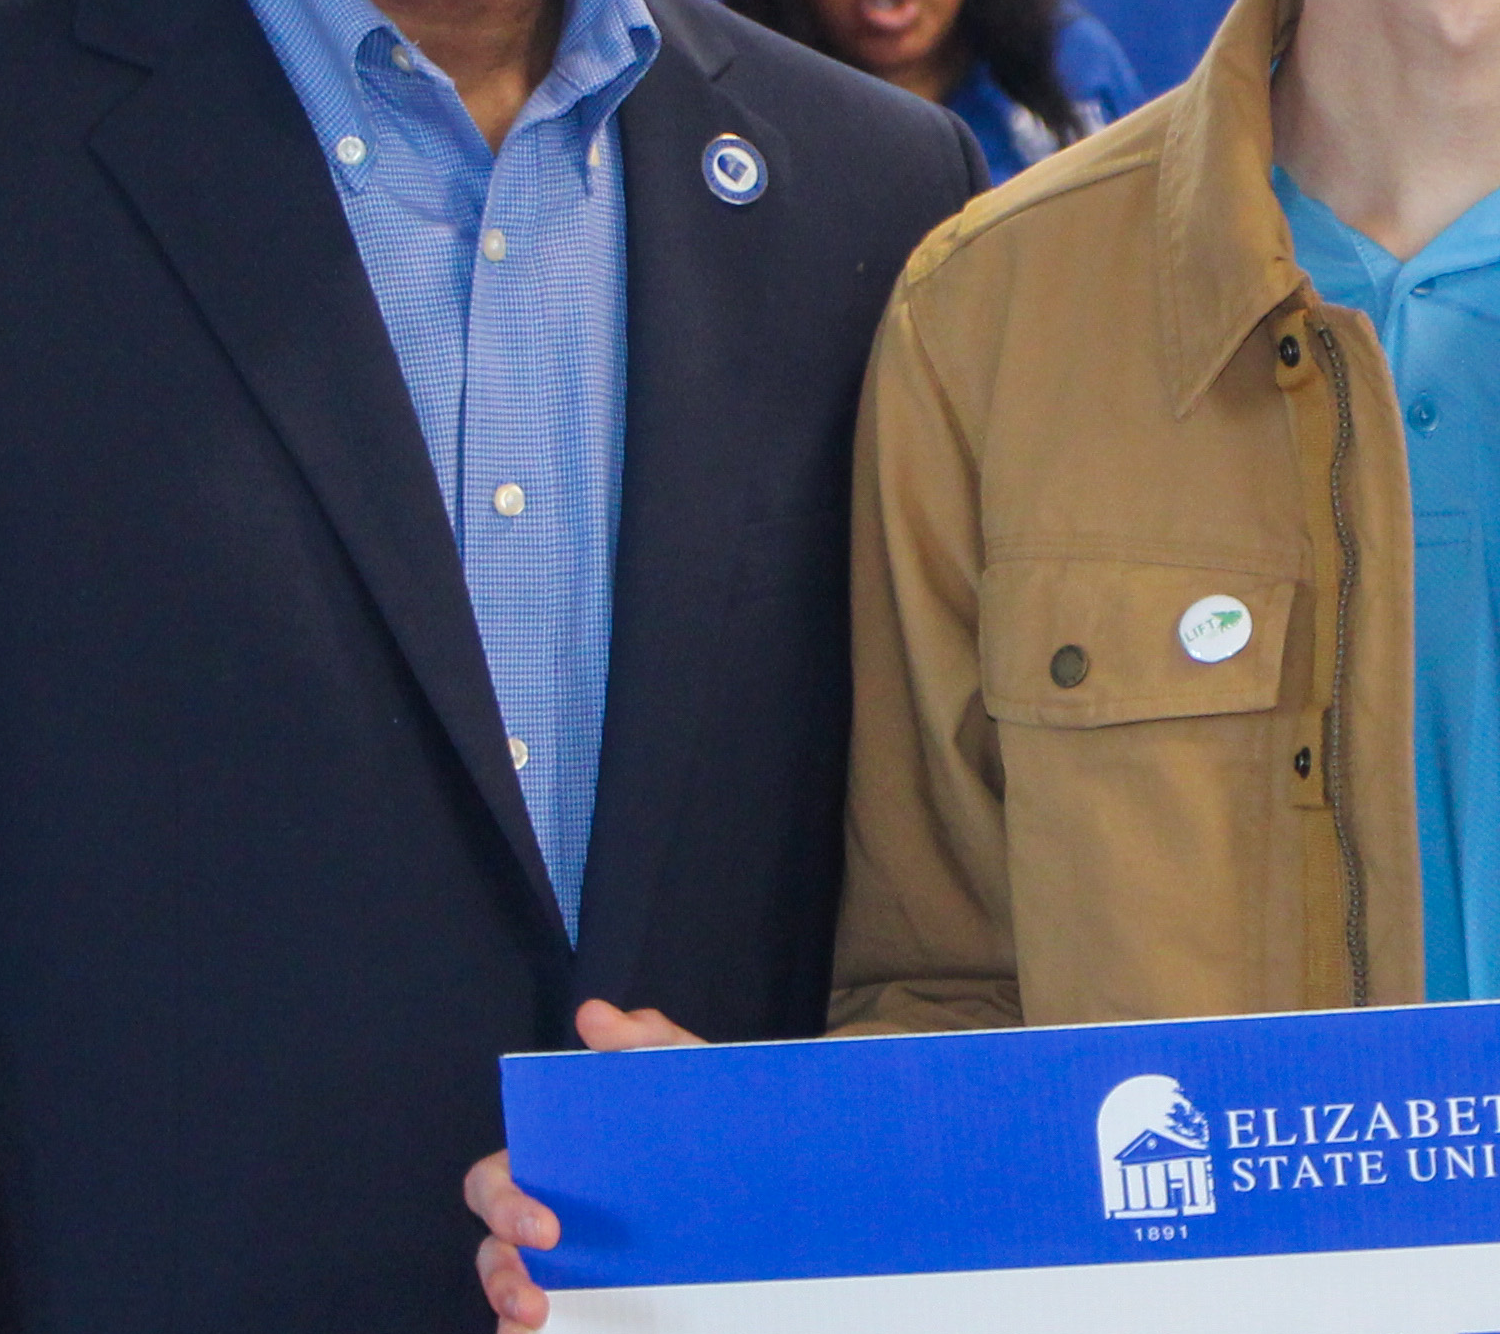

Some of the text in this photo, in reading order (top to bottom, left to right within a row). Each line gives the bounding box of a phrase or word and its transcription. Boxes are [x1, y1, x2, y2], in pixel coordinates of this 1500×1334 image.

[1184, 618, 1214, 643] LIFT
[1232, 1150, 1388, 1192] STATE
[1134, 1224, 1189, 1242] 1891
